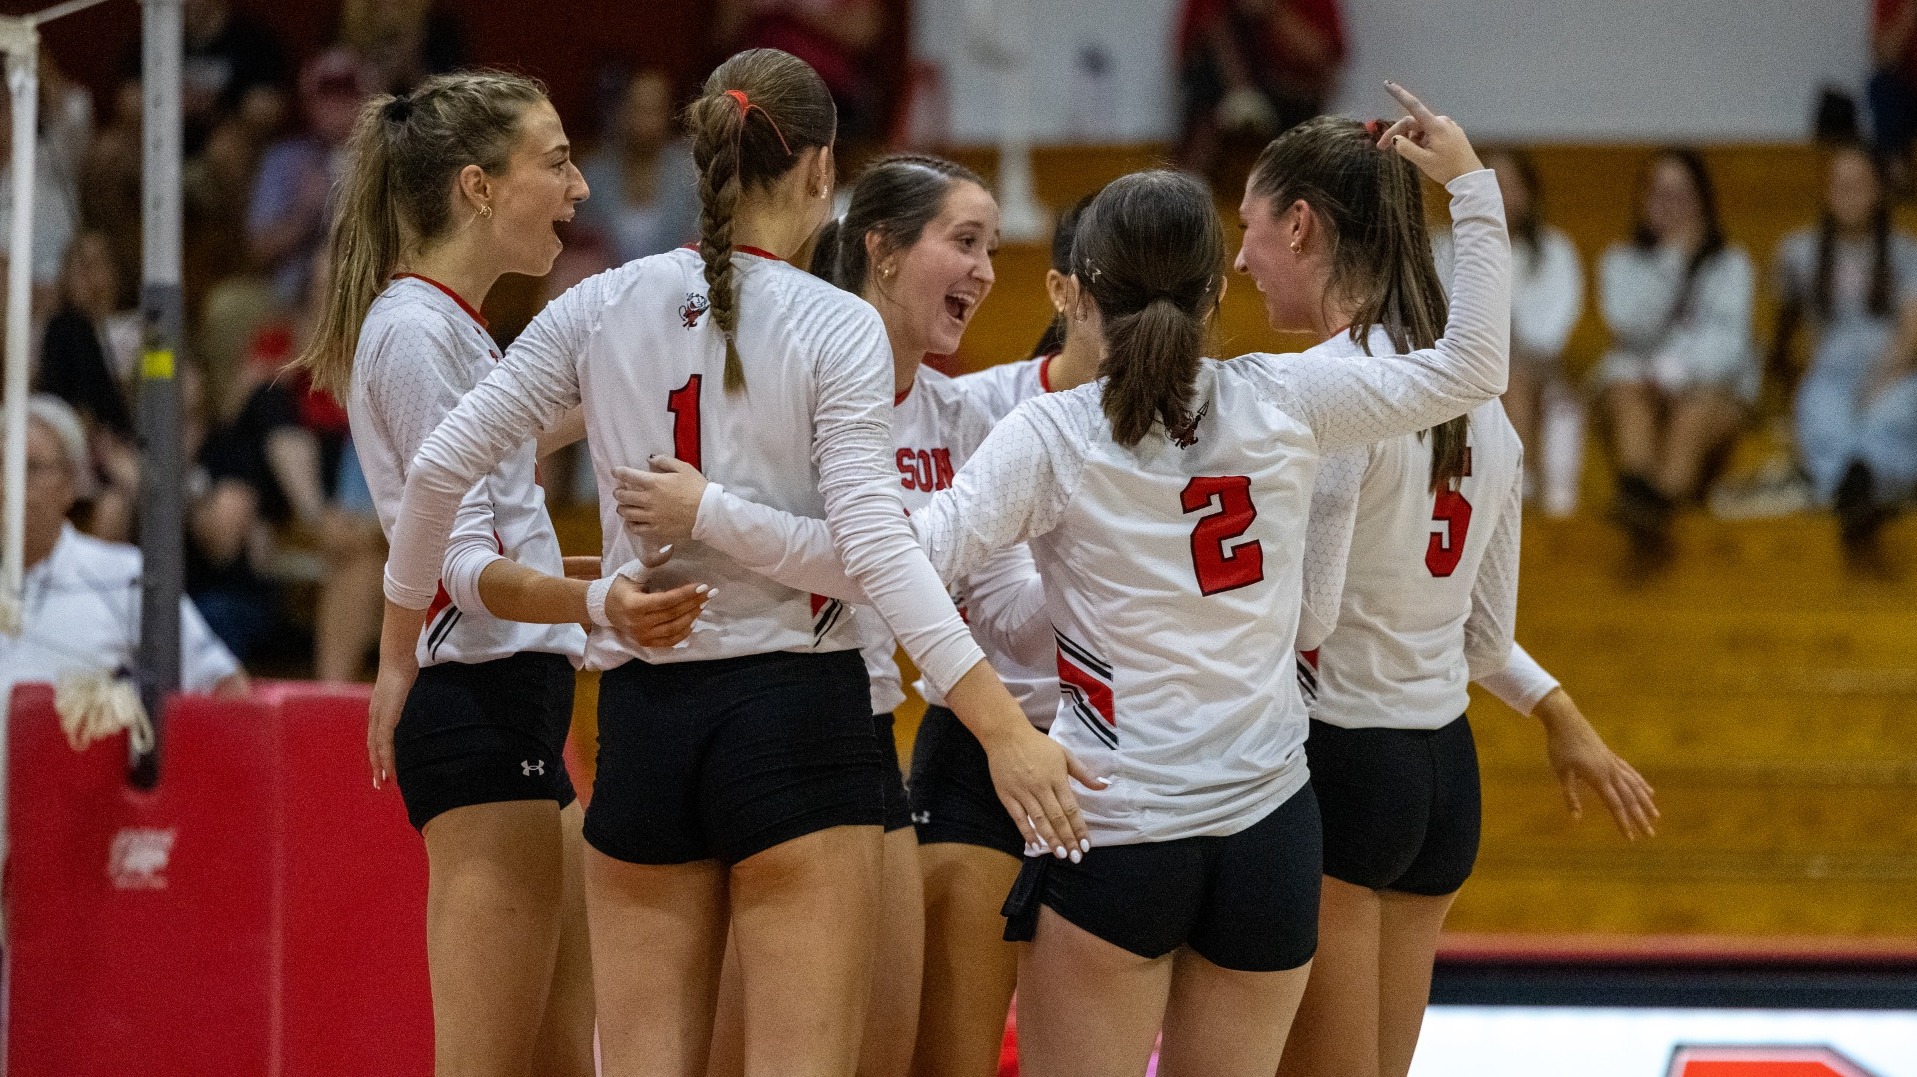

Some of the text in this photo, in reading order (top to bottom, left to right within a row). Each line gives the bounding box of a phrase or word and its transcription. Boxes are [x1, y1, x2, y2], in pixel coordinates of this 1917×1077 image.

[667, 374, 703, 475] 1
[1180, 475, 1264, 597] 2
[1425, 446, 1473, 578] 5
